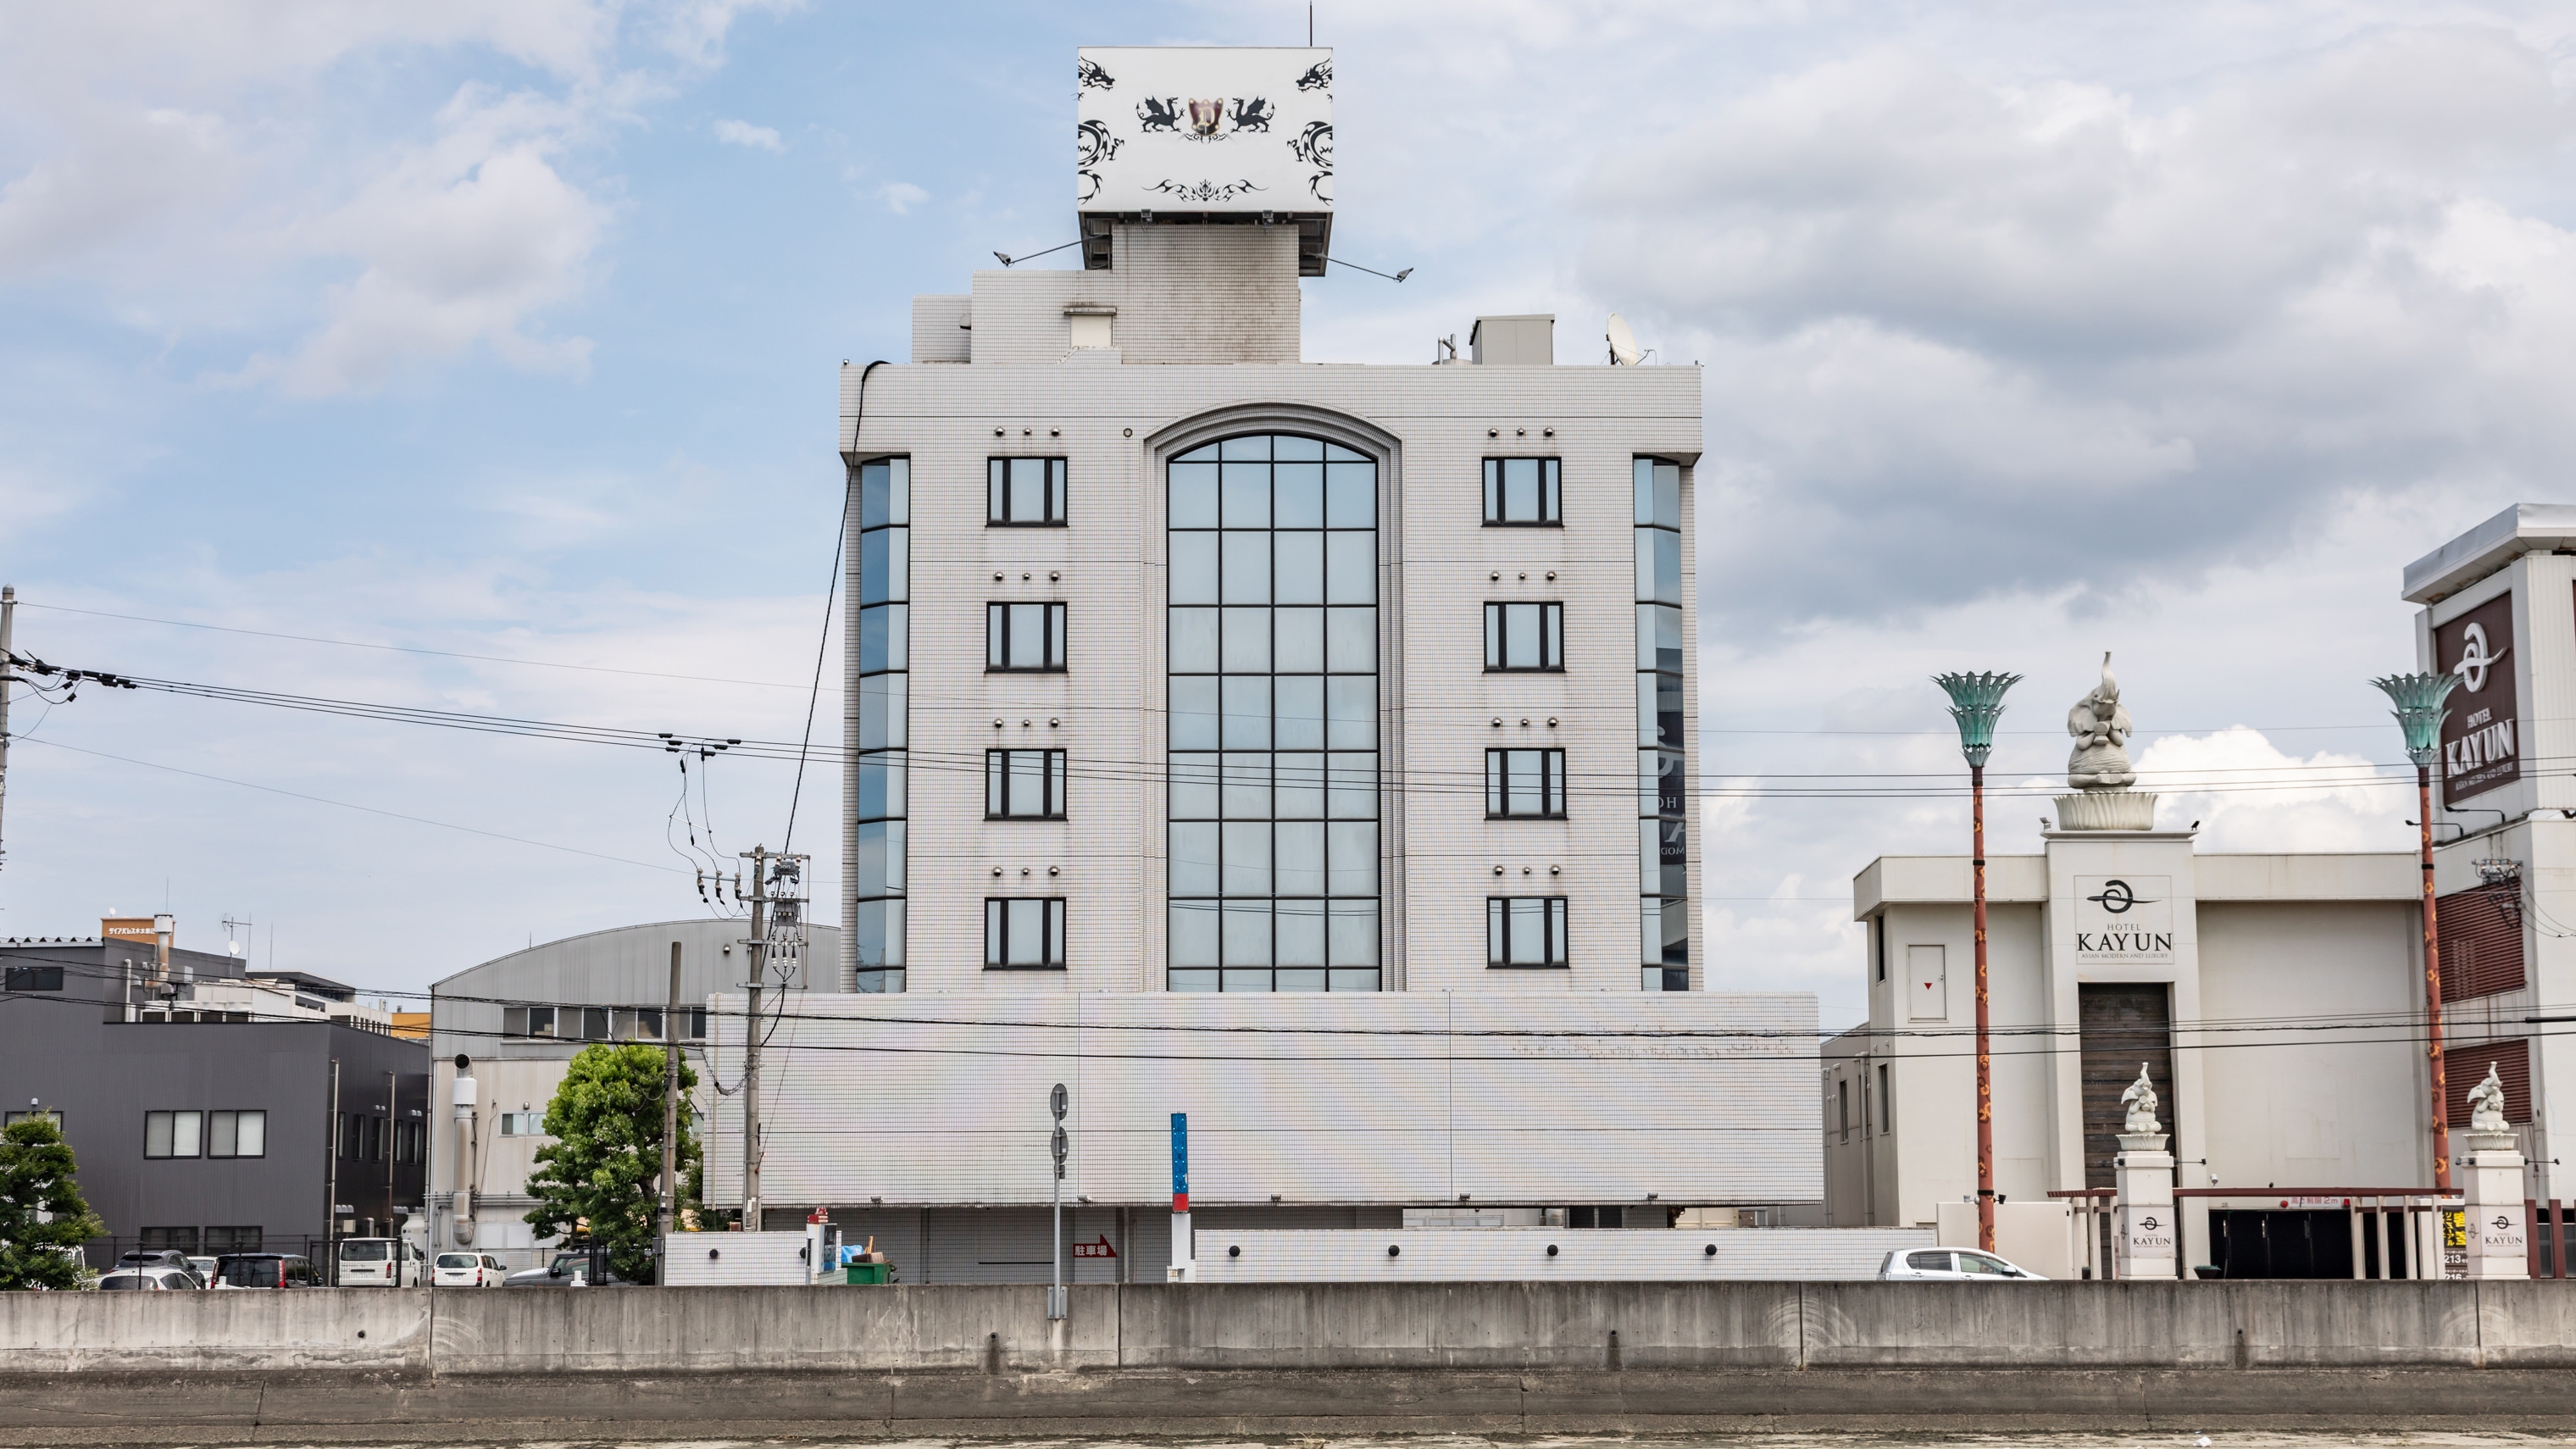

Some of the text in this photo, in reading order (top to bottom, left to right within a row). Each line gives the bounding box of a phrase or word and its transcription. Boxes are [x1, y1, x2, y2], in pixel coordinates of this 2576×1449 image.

[2467, 707, 2493, 730] HOTEL
[2445, 719, 2515, 779] KAYUN
[2076, 933, 2173, 952] KAYUN
[1074, 1245, 1108, 1256] 駐車場
